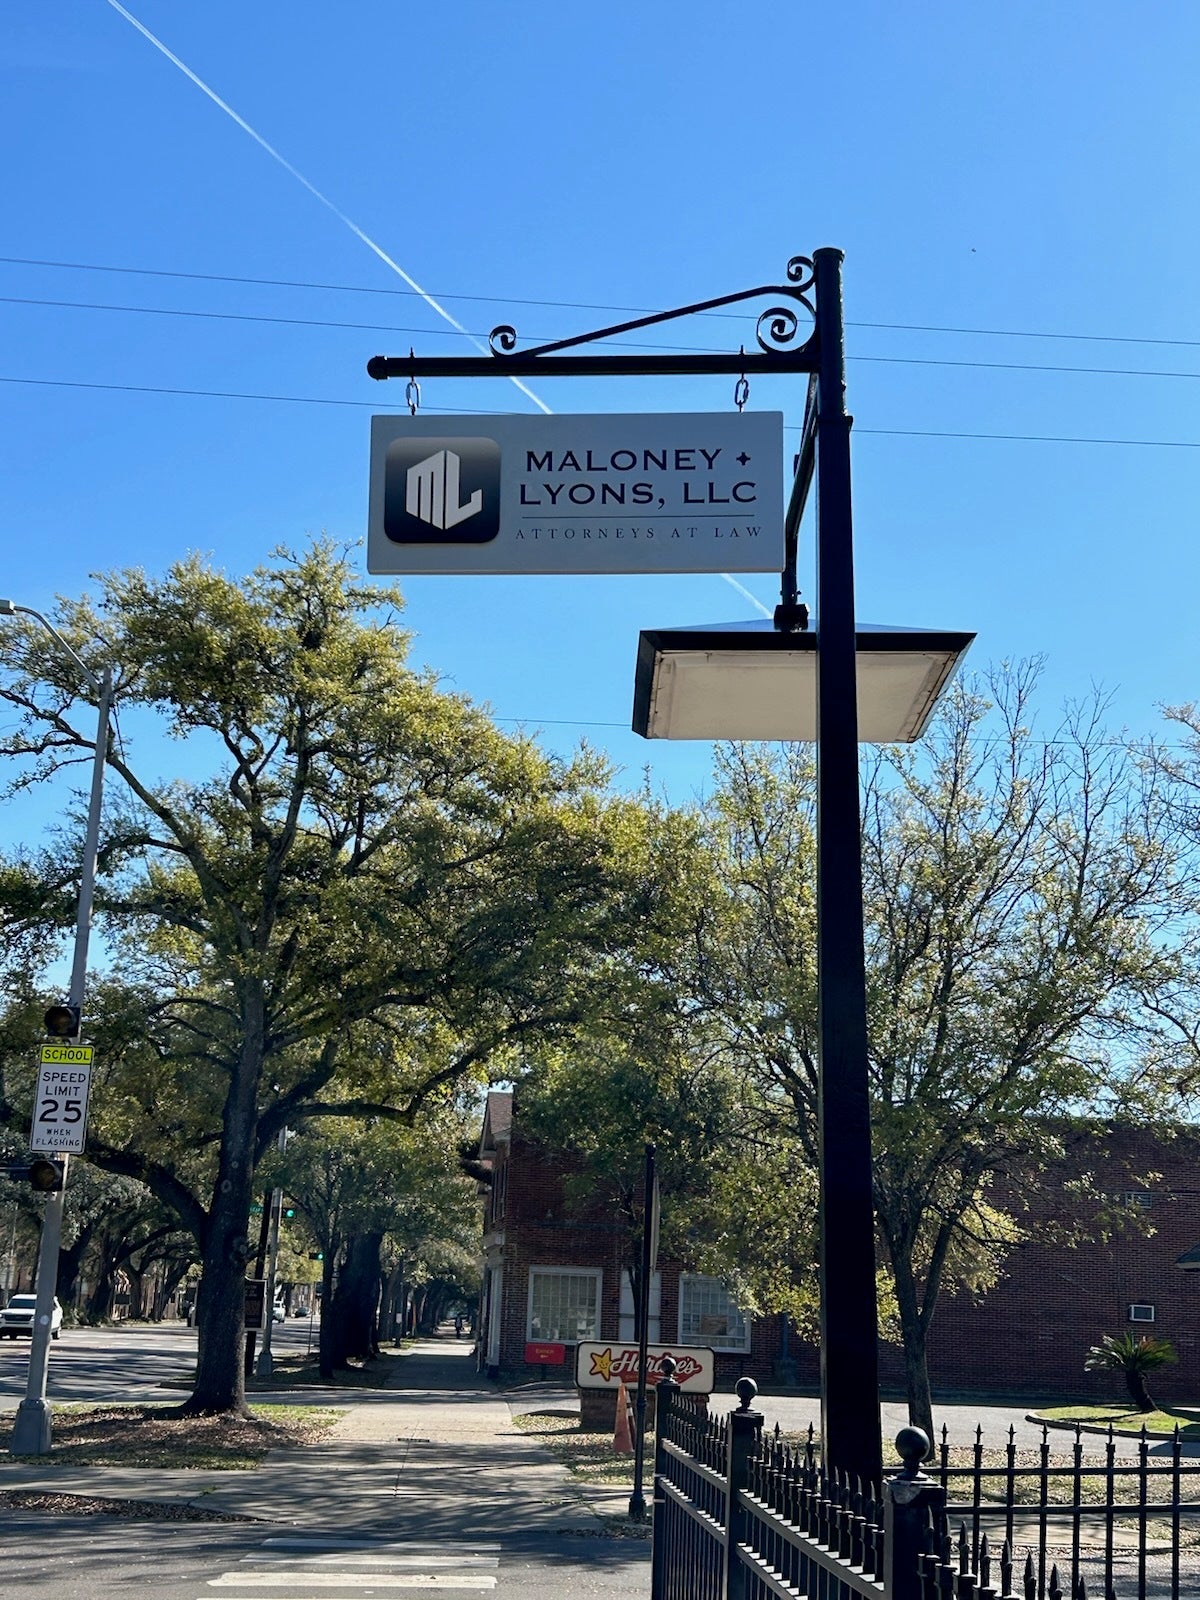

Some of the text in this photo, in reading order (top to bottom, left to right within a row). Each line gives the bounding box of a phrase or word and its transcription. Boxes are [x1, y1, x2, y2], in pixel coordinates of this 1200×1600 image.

[526, 448, 722, 472] MALONEY
[519, 481, 757, 510] LYONS, LLC
[515, 526, 761, 540] ATTORNEYS AT LAW
[44, 1049, 90, 1061] SCHOOL
[42, 1071, 86, 1083] SPEED
[45, 1085, 81, 1097] LIMIT
[39, 1099, 82, 1124] 25
[46, 1128, 71, 1136] WHEN
[35, 1138, 80, 1147] FLASHING
[609, 1352, 700, 1374] Hre's
